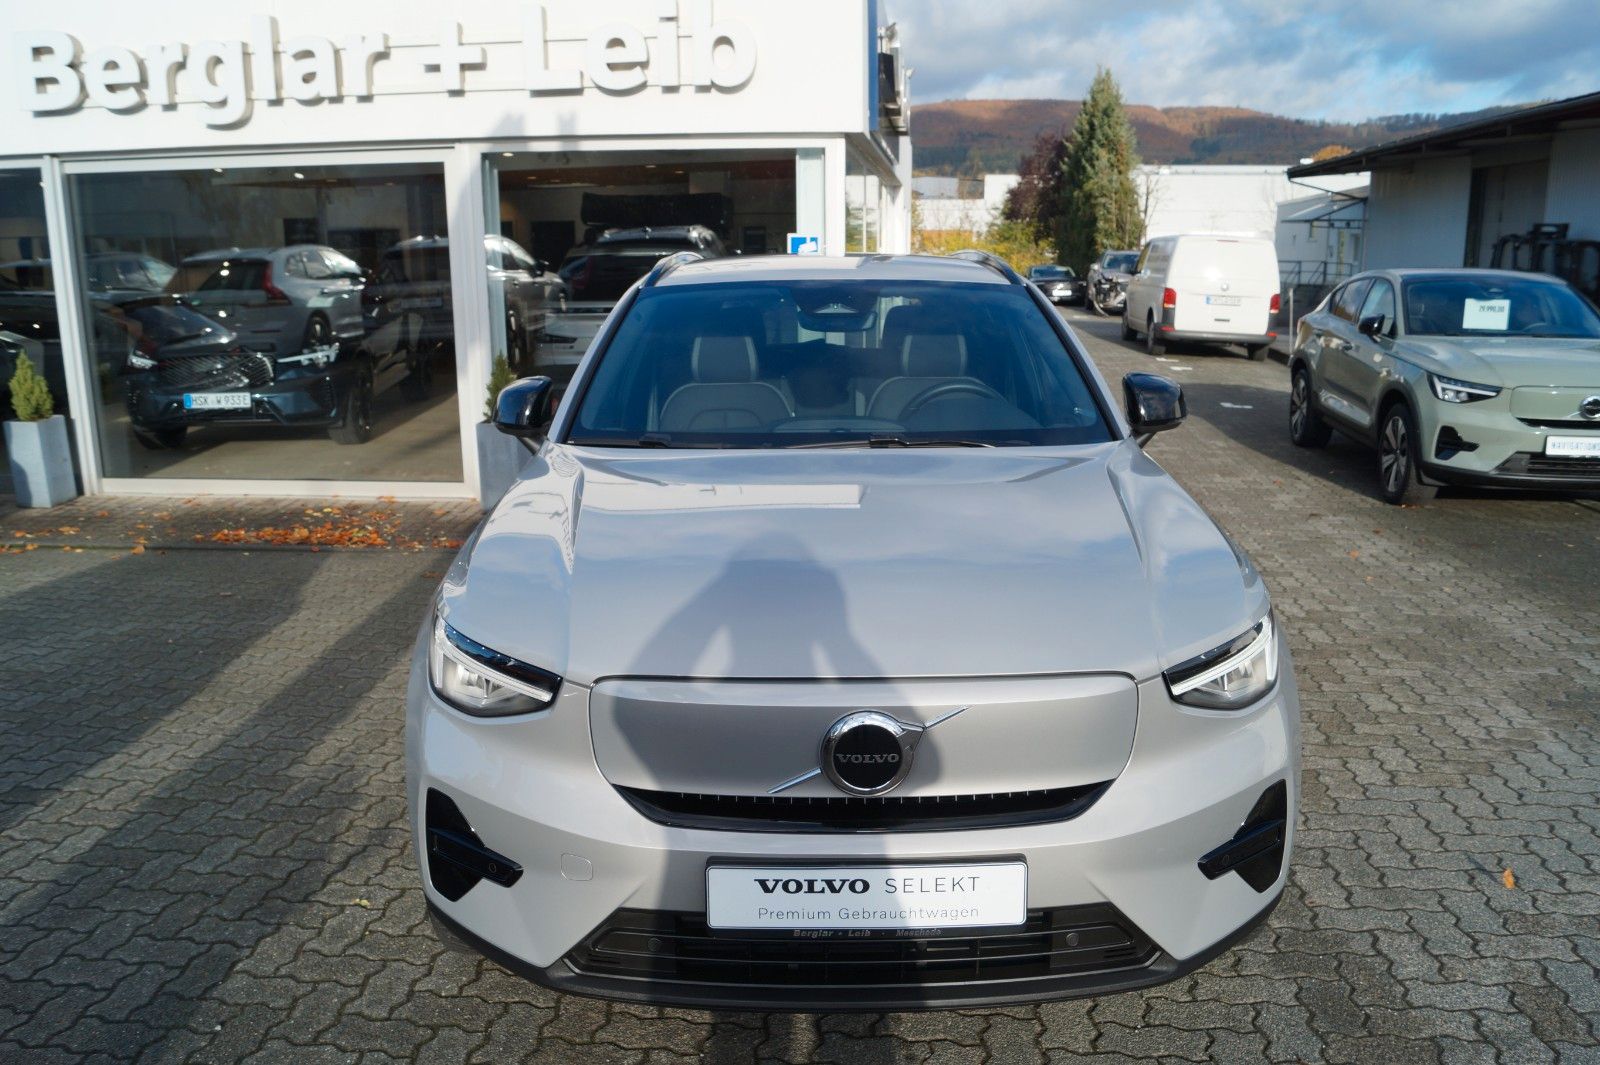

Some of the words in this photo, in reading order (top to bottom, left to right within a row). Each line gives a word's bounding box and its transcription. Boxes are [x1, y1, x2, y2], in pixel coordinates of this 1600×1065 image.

[17, 14, 391, 131] Berglar
[422, 20, 487, 97] +
[520, 0, 758, 97] Leib
[835, 753, 900, 764] VOLVO
[754, 878, 870, 894] VOLVO
[884, 876, 980, 894] SELEKT
[758, 907, 831, 920] Premium
[838, 905, 979, 921] Gebrauchtwagen
